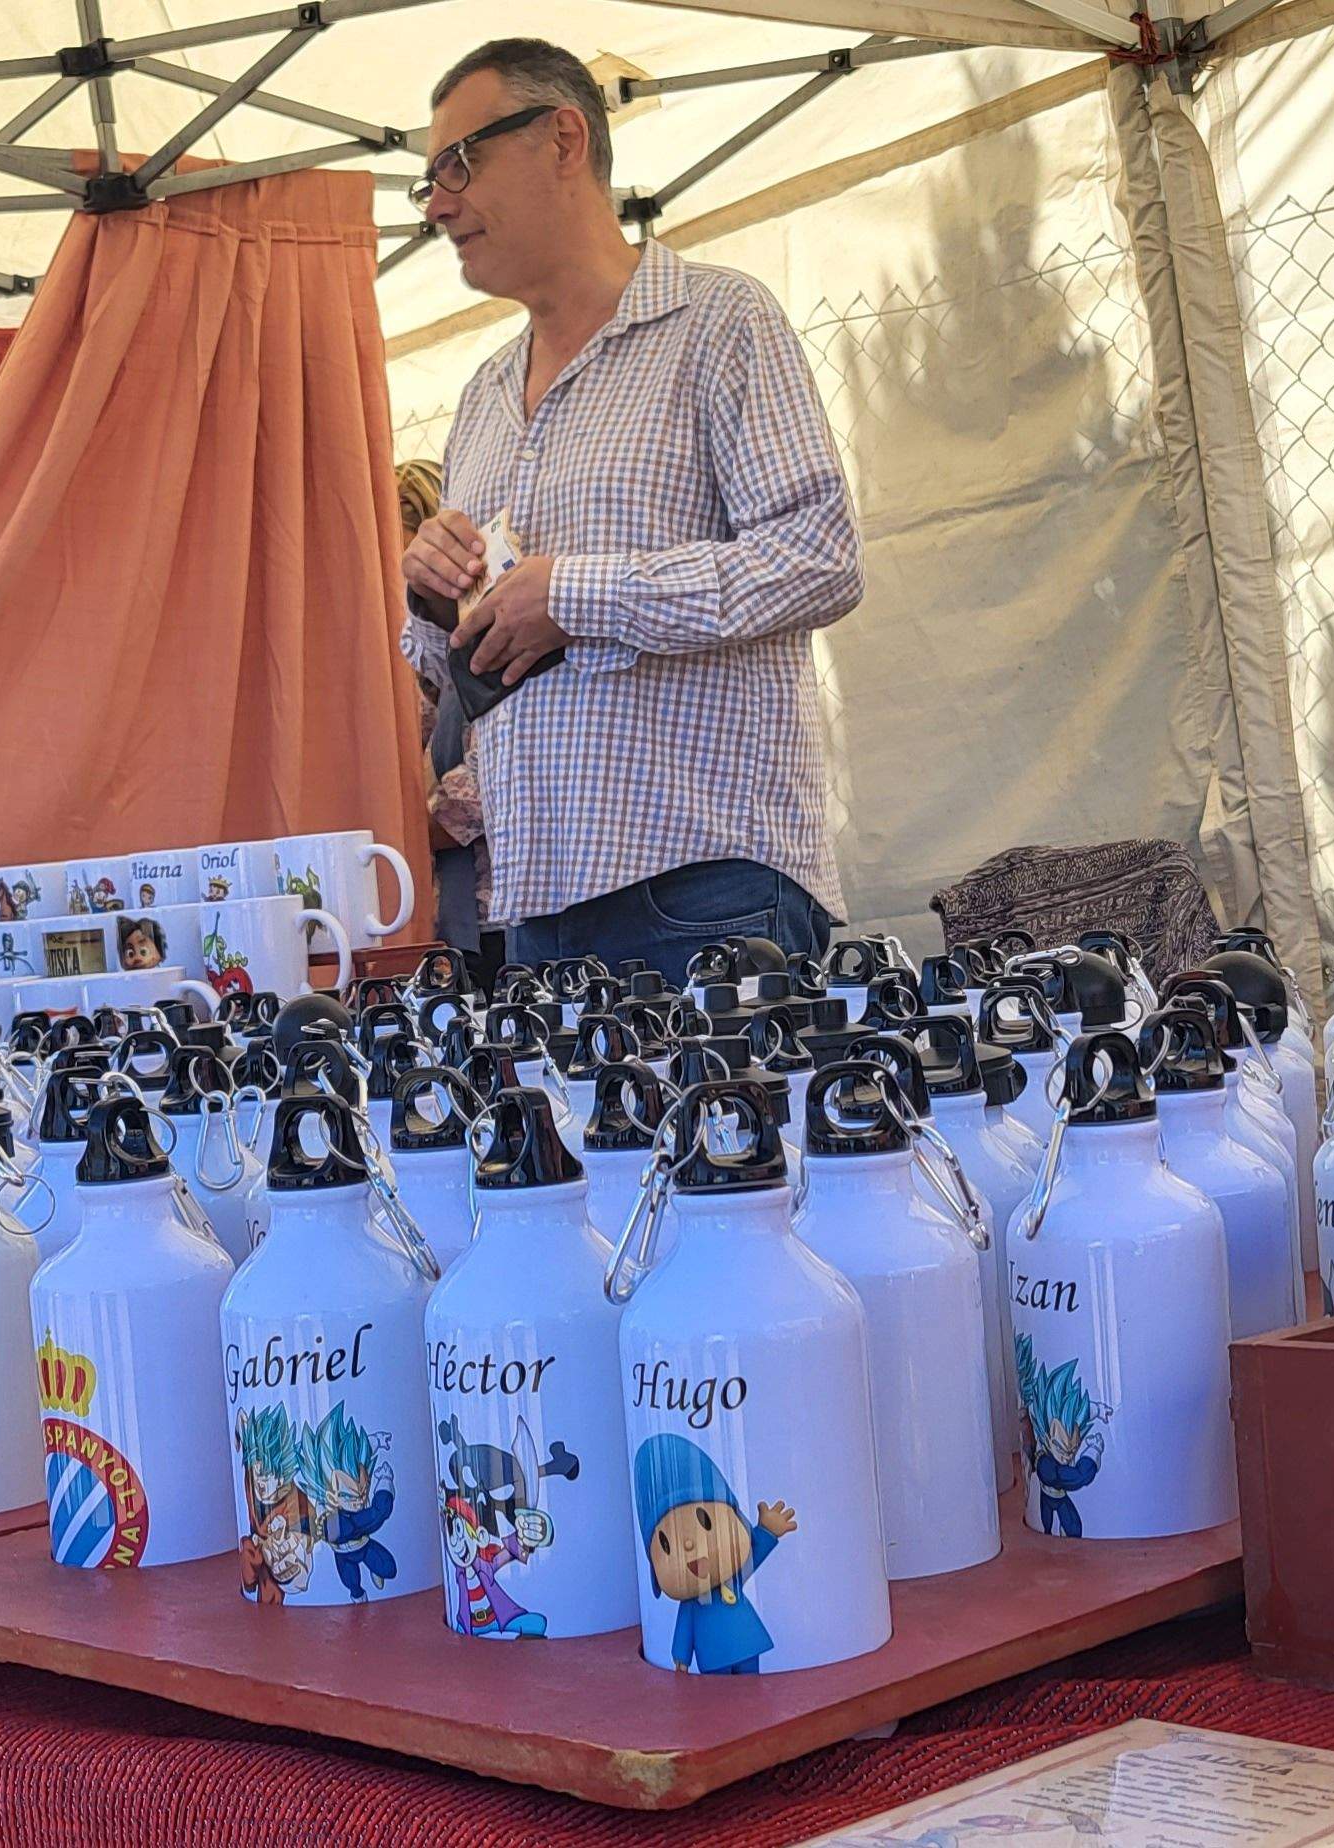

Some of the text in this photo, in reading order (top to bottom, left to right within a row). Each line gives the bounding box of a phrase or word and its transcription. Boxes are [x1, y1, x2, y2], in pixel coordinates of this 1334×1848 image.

[131, 861, 183, 881] Aitana
[201, 848, 239, 870] Oriol
[1009, 1260, 1080, 1313] Izan
[225, 1323, 373, 1404] Gabriel
[426, 1341, 556, 1395] Héctor
[632, 1360, 747, 1429] Hugo
[44, 1425, 137, 1505] SPANYOL
[1183, 1752, 1294, 1776] ALICIA
